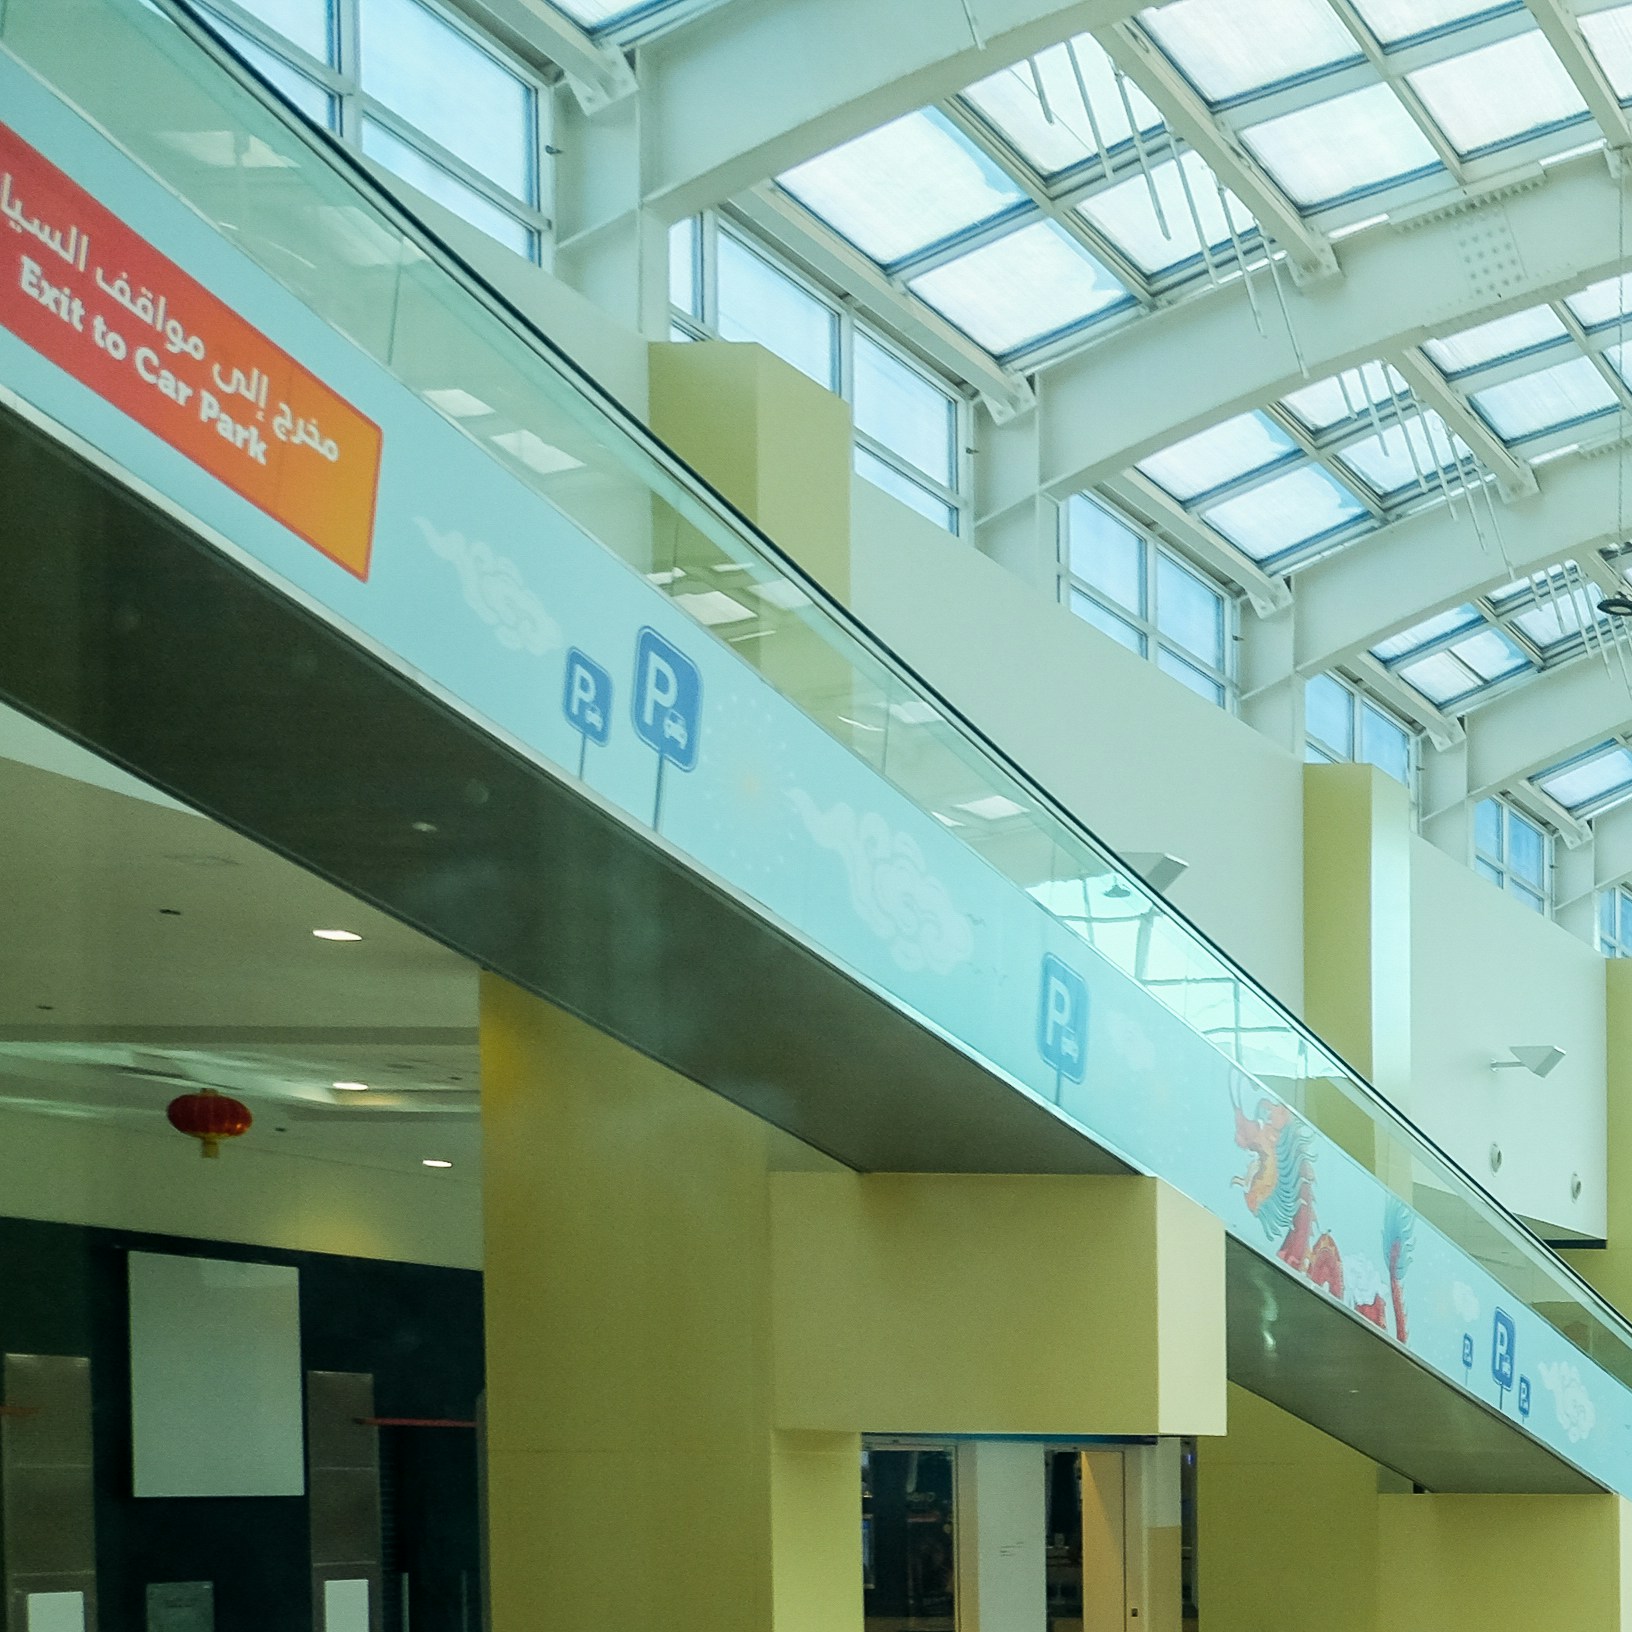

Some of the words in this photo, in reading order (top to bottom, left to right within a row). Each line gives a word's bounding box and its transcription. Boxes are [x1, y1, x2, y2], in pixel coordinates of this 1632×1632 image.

[0, 172, 90, 273] السيا
[20, 255, 85, 332] Exit
[93, 315, 127, 360] to
[135, 346, 193, 406] Car
[200, 390, 267, 465] Park
[96, 266, 206, 360] مواقف
[212, 362, 269, 422] إلى
[272, 402, 340, 463] مخرج
